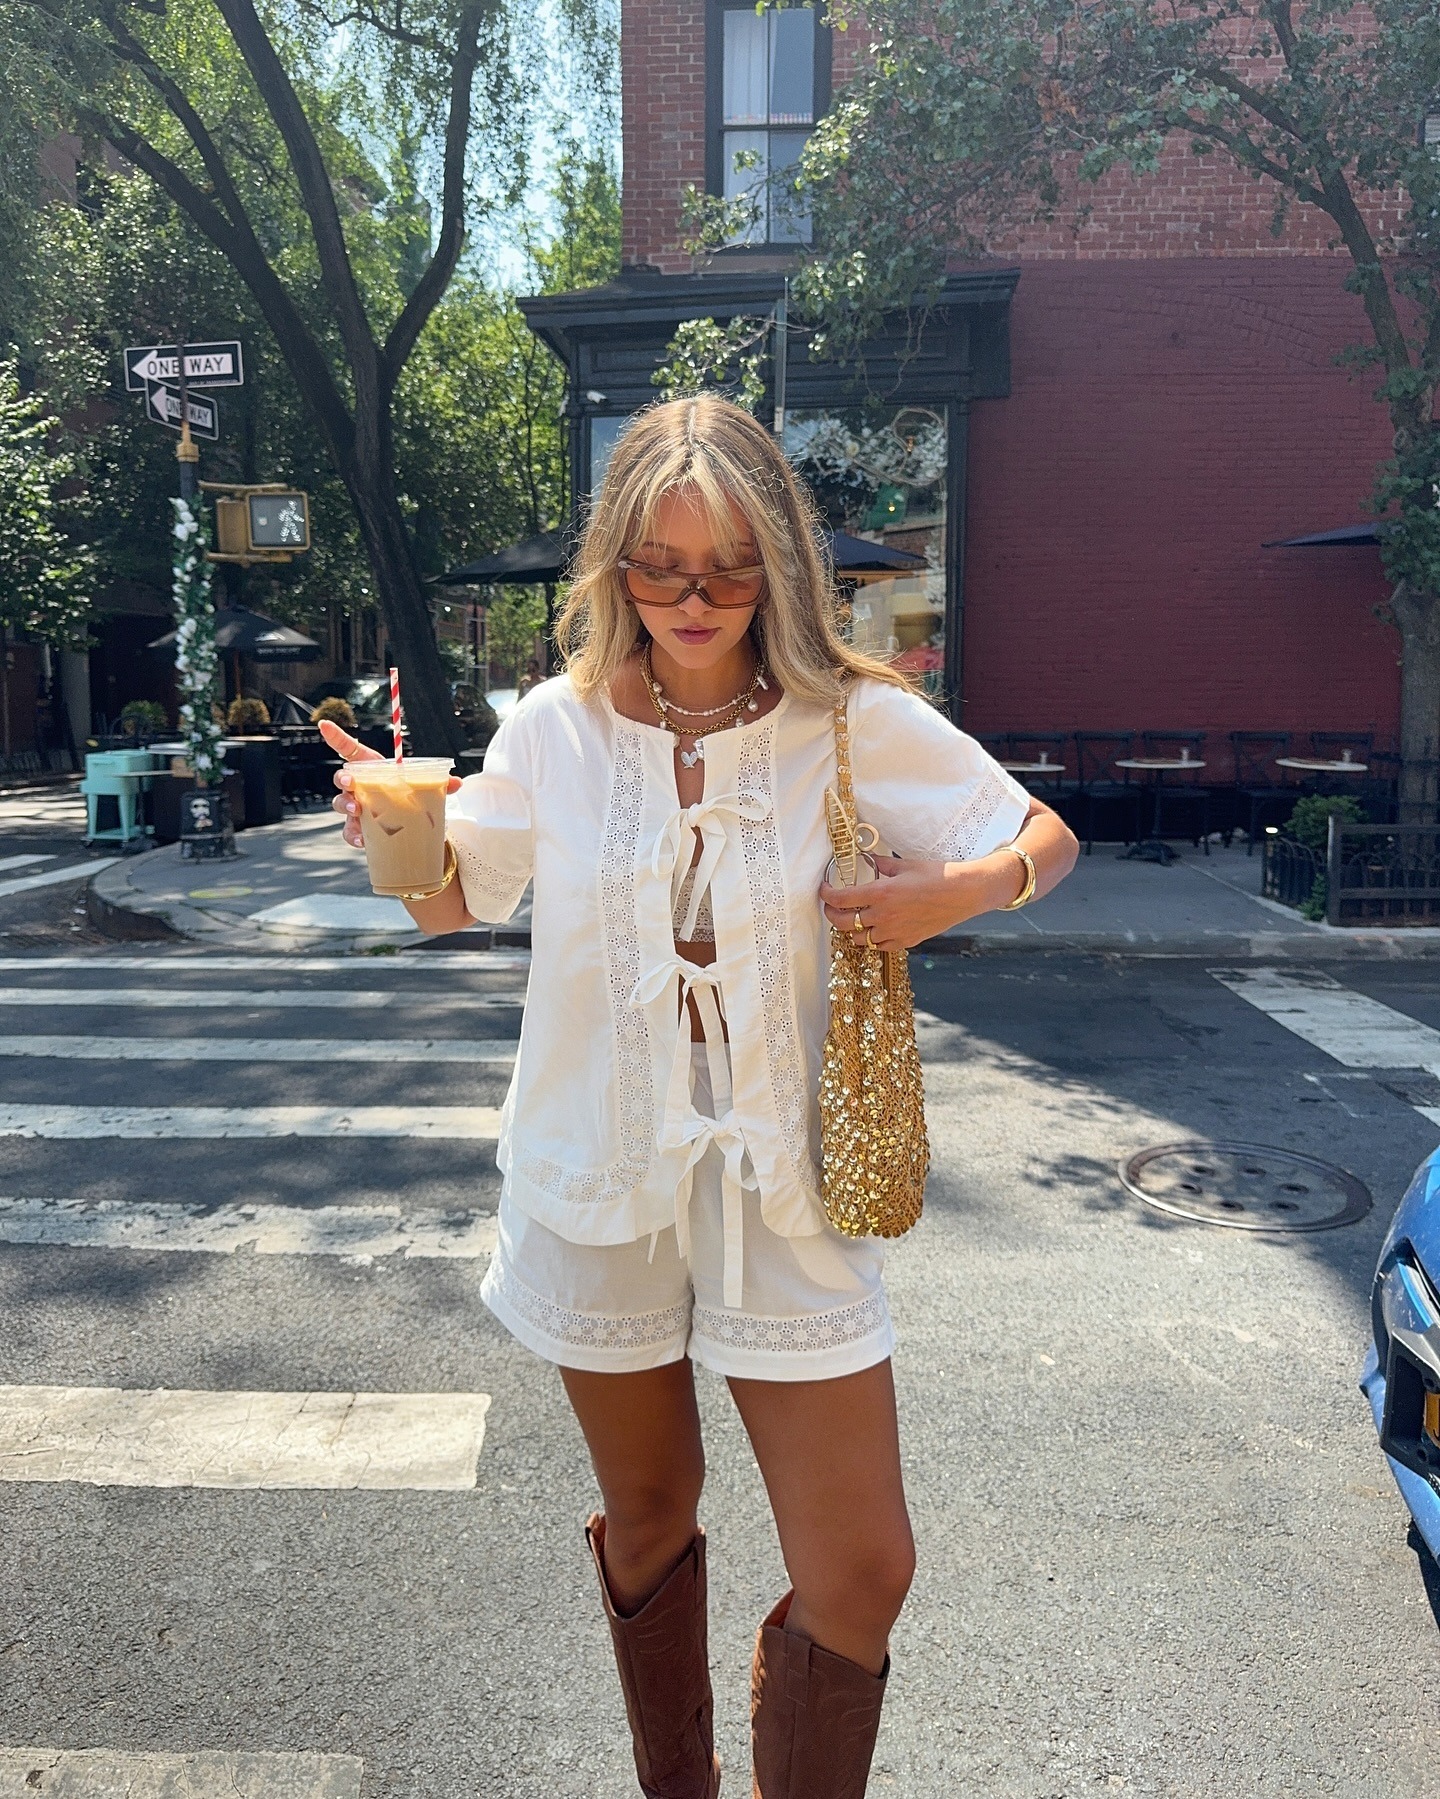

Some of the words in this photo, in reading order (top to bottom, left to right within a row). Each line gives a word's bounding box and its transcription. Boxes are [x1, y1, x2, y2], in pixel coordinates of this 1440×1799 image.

[147, 360, 180, 376] ONE
[190, 357, 224, 373] WAY
[165, 397, 182, 416] ON
[189, 405, 209, 424] WAY
